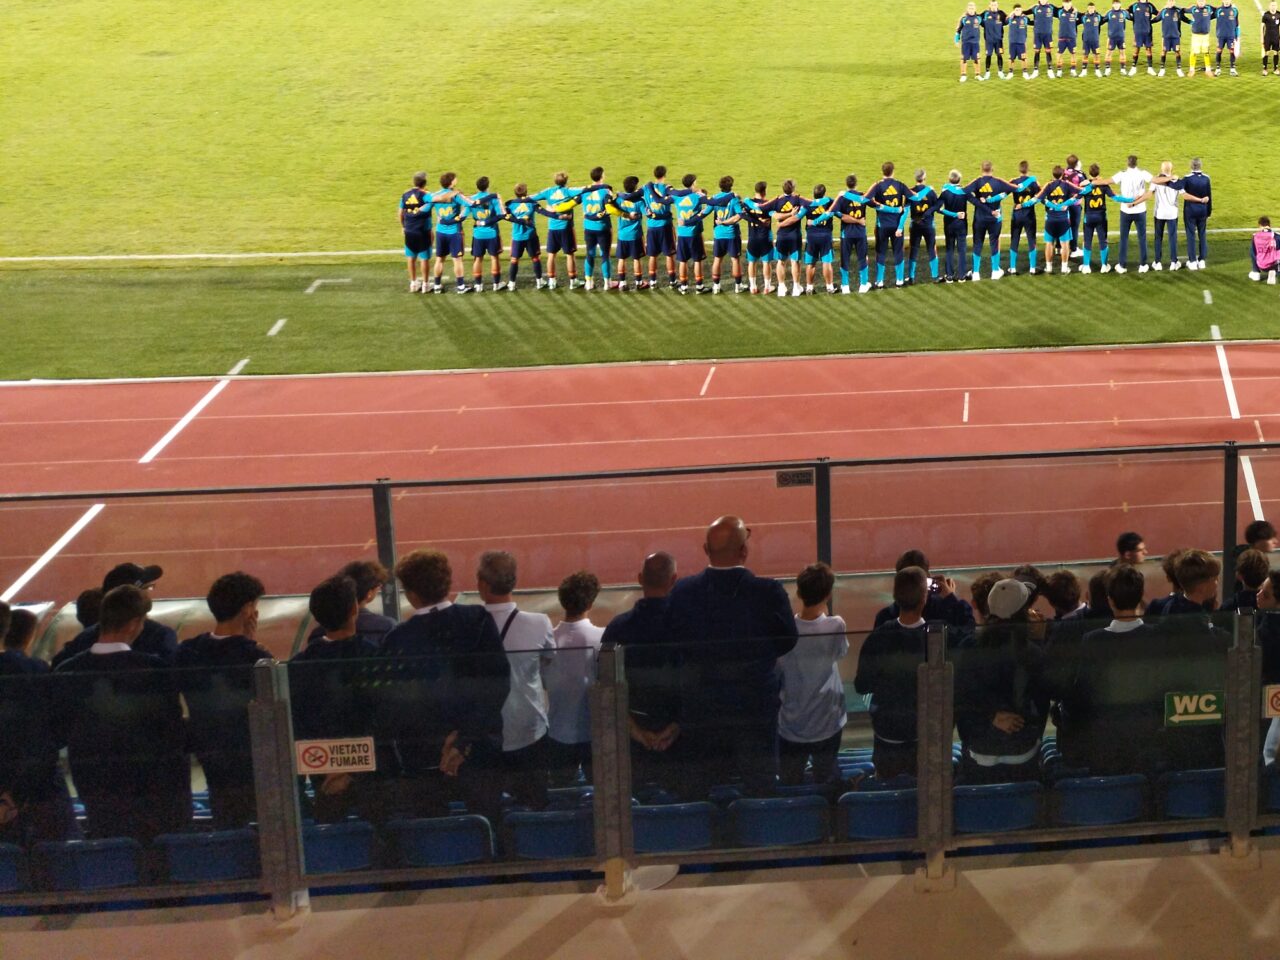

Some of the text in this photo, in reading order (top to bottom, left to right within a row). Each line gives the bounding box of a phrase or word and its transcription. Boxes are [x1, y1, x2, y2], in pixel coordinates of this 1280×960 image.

[1173, 693, 1217, 713] WC
[328, 743, 369, 755] VIETATO
[330, 755, 370, 767] FUMARE
